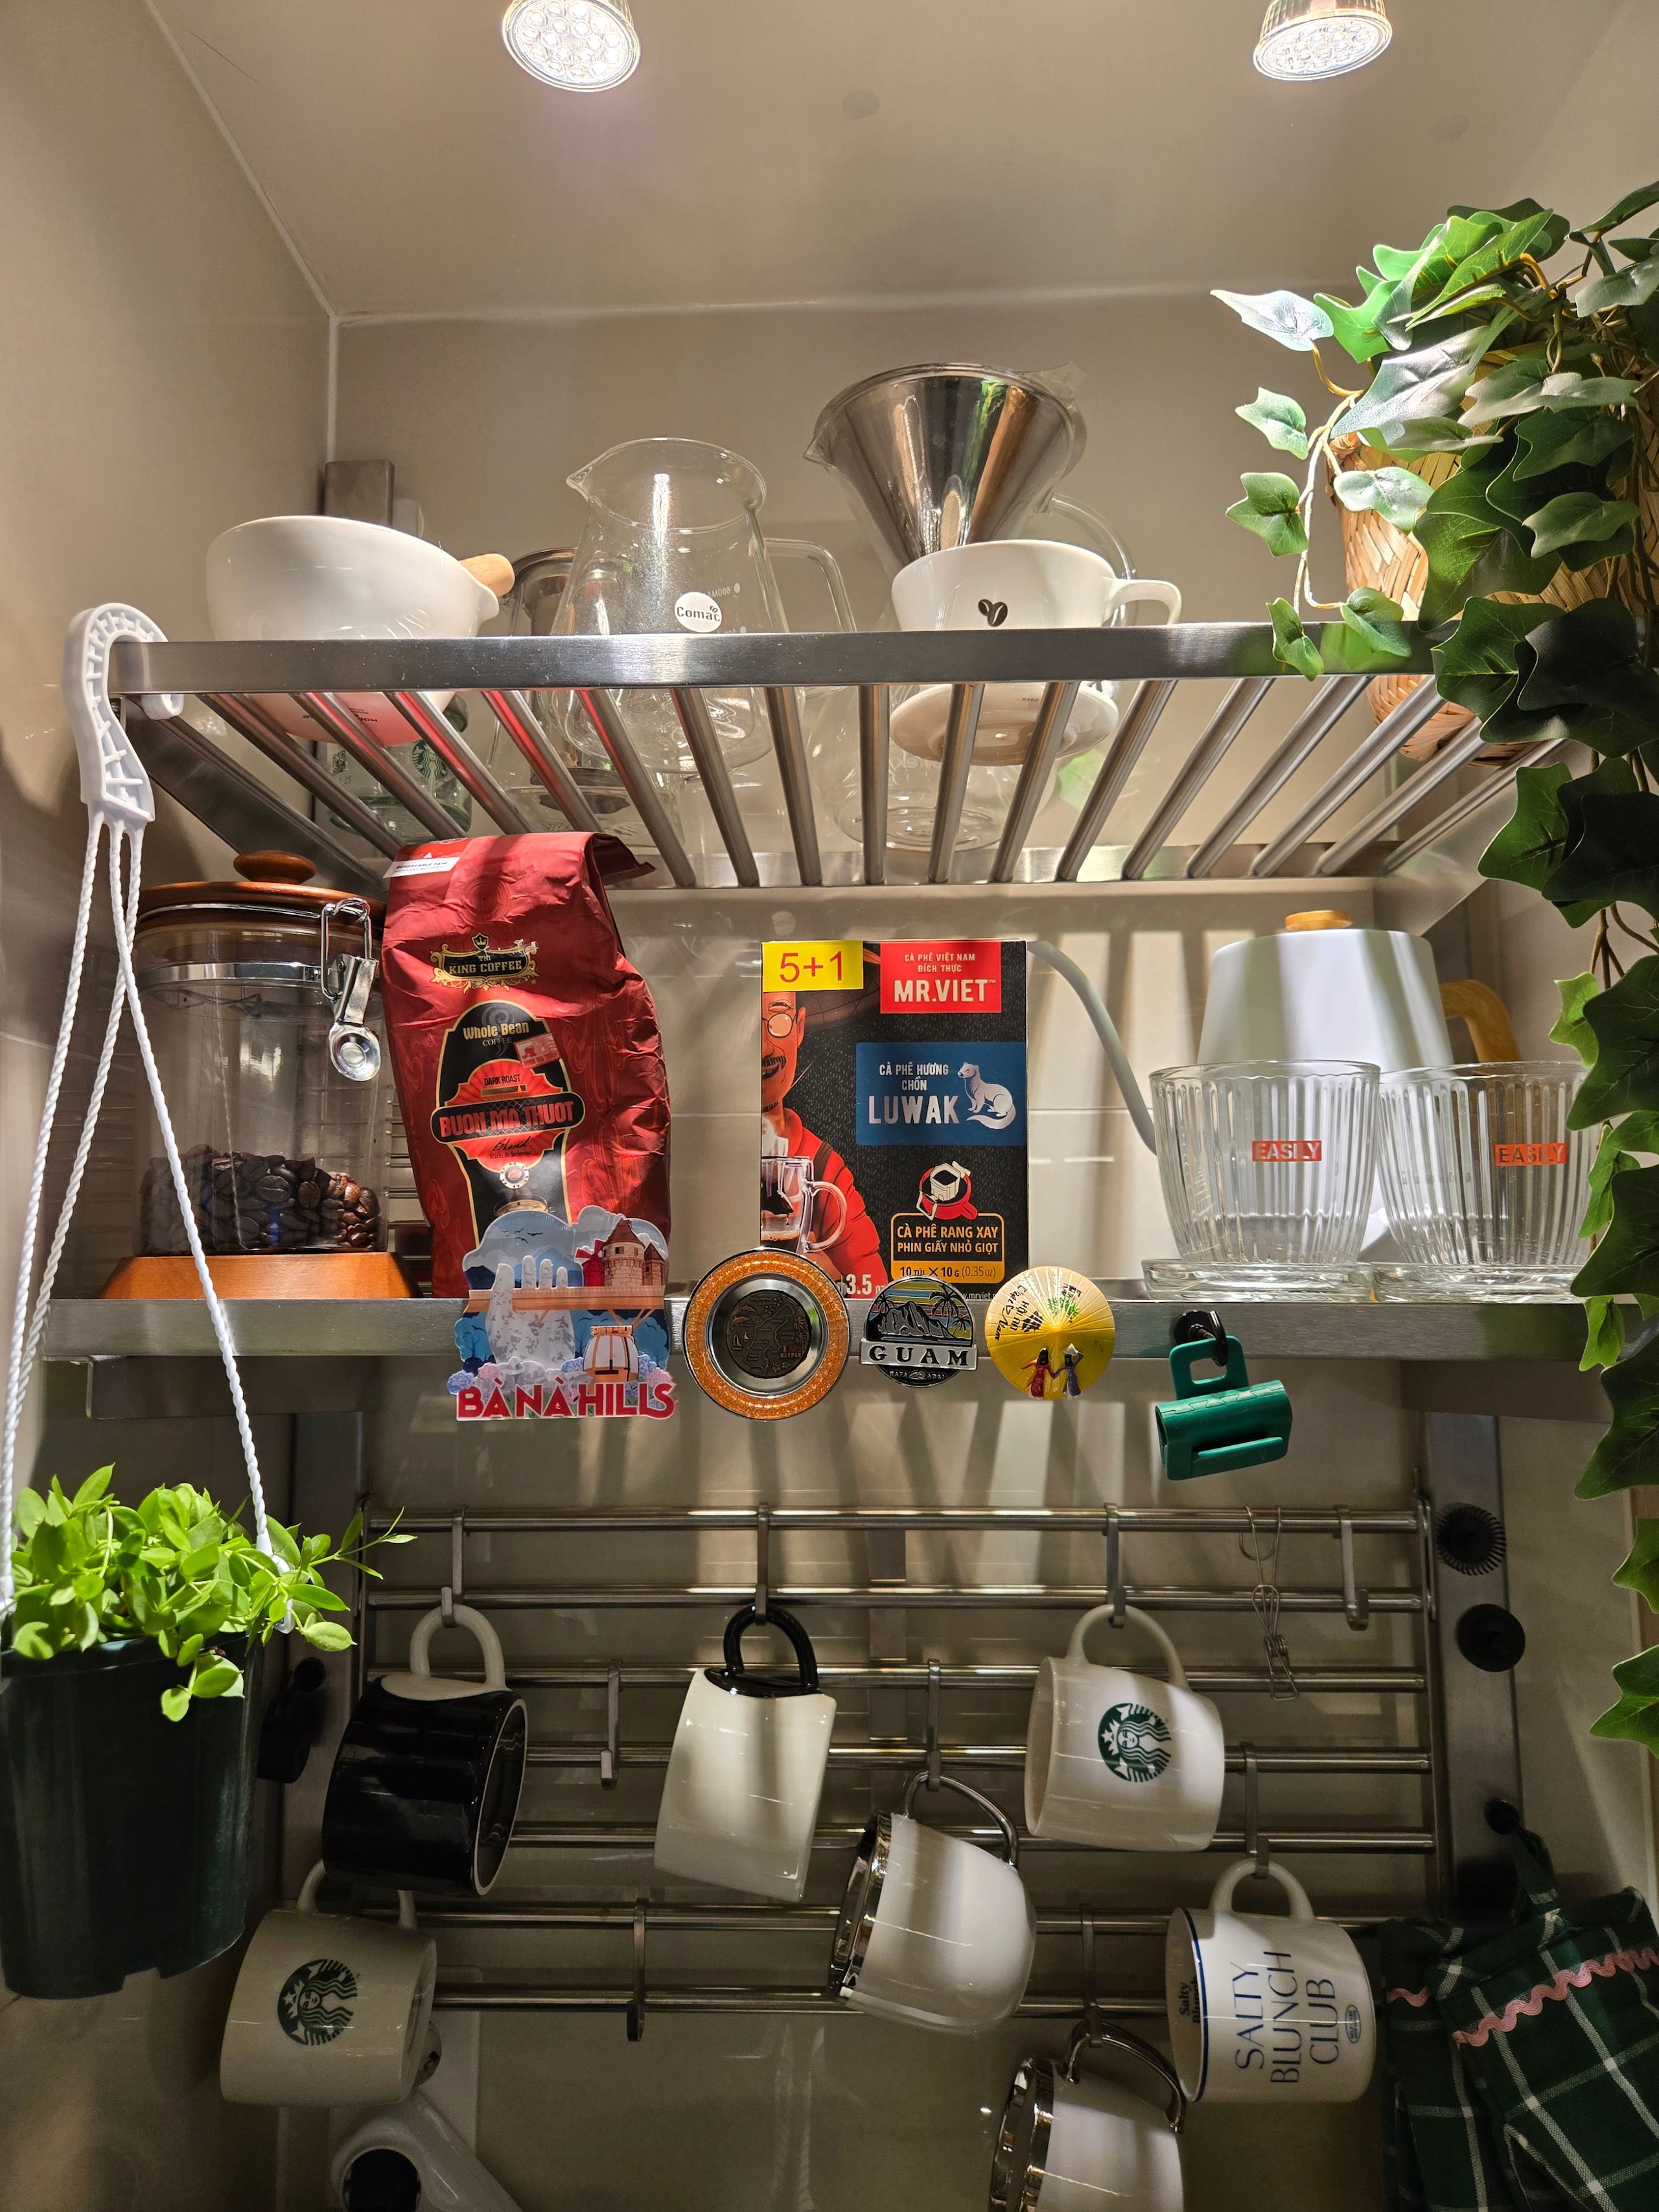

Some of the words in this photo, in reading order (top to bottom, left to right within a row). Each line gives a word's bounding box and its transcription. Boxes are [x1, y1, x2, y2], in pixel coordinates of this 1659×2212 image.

[677, 607, 721, 622] Comac
[905, 952, 914, 962] CÀ
[918, 953, 933, 962] PHÊ
[936, 953, 953, 964] VIỆT
[448, 964, 477, 974] KING
[480, 960, 522, 972] COFFEE
[780, 951, 842, 983] 5+1
[918, 964, 938, 973] ĐÍCH
[941, 964, 962, 974] THỰC
[463, 1025, 498, 1040] Whole
[500, 1022, 529, 1036] Bean
[482, 1038, 512, 1047] COFFEE
[879, 1062, 892, 1076] CÀ
[896, 1062, 912, 1076] PHÊ
[917, 1063, 949, 1076] HƯƠNG
[483, 1077, 501, 1086] DARK
[502, 1074, 521, 1083] ROAST
[901, 1076, 927, 1091] CHỒN
[868, 1095, 960, 1124] LUWAK
[439, 1112, 487, 1137] BUON
[487, 1108, 520, 1130] MA
[522, 1101, 574, 1126] THUOT
[492, 1136, 531, 1152] Blend
[1255, 1143, 1319, 1159] EASILY
[1498, 1145, 1564, 1163] EASILY
[897, 1223, 912, 1239] CÀ
[916, 1223, 936, 1239] PHÊ
[941, 1226, 973, 1239] RANG
[977, 1226, 998, 1239] XAY
[898, 1242, 922, 1252] PHIN
[925, 1239, 947, 1252] GIẤY
[950, 1239, 971, 1252] NHỎ
[975, 1242, 999, 1255] GIỌT
[900, 1266, 912, 1276] 10
[941, 1266, 953, 1277] 10
[962, 1266, 984, 1279] (0.35
[985, 1266, 996, 1279] oz)
[846, 1274, 872, 1295] 3.5
[868, 1345, 969, 1366] GUAM
[458, 1377, 512, 1418] BÀ
[516, 1376, 573, 1418] NÀ
[578, 1382, 676, 1420] HILLS
[1178, 1981, 1192, 2016] Salty
[1229, 1961, 1264, 2069] SALTY
[1263, 1951, 1302, 2084] BLUNCH
[1305, 1978, 1340, 2066] CLUB
